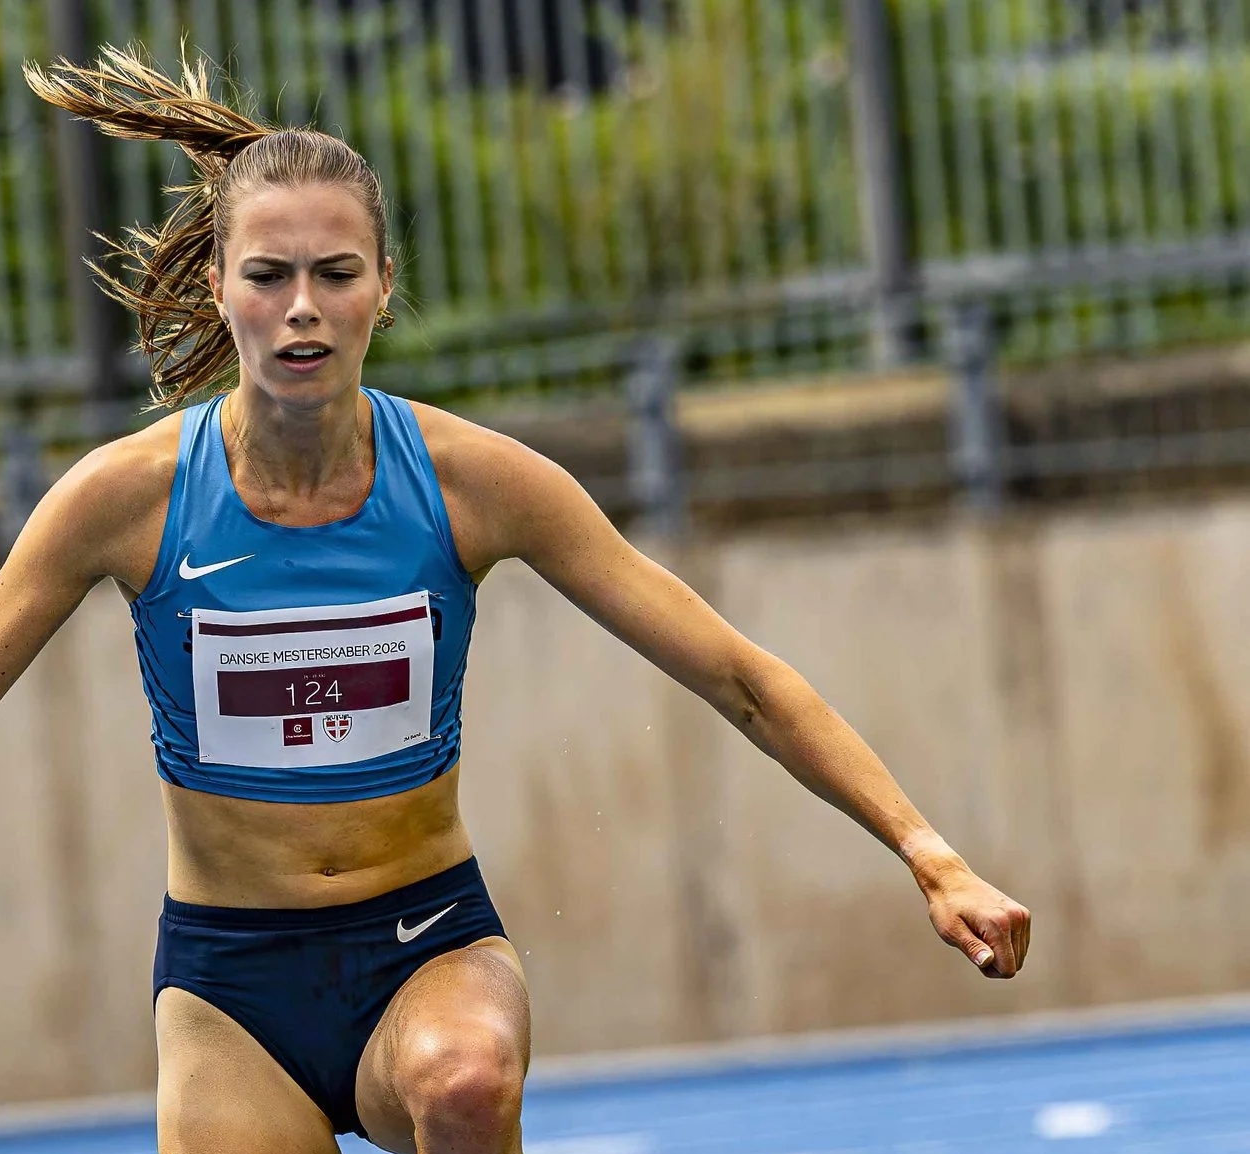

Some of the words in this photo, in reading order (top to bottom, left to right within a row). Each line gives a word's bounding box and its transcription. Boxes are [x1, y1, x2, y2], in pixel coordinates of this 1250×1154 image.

[220, 652, 270, 665] DANSKE
[273, 645, 371, 663] MESTERSKABER
[373, 640, 406, 656] 2026
[285, 679, 343, 707] 124
